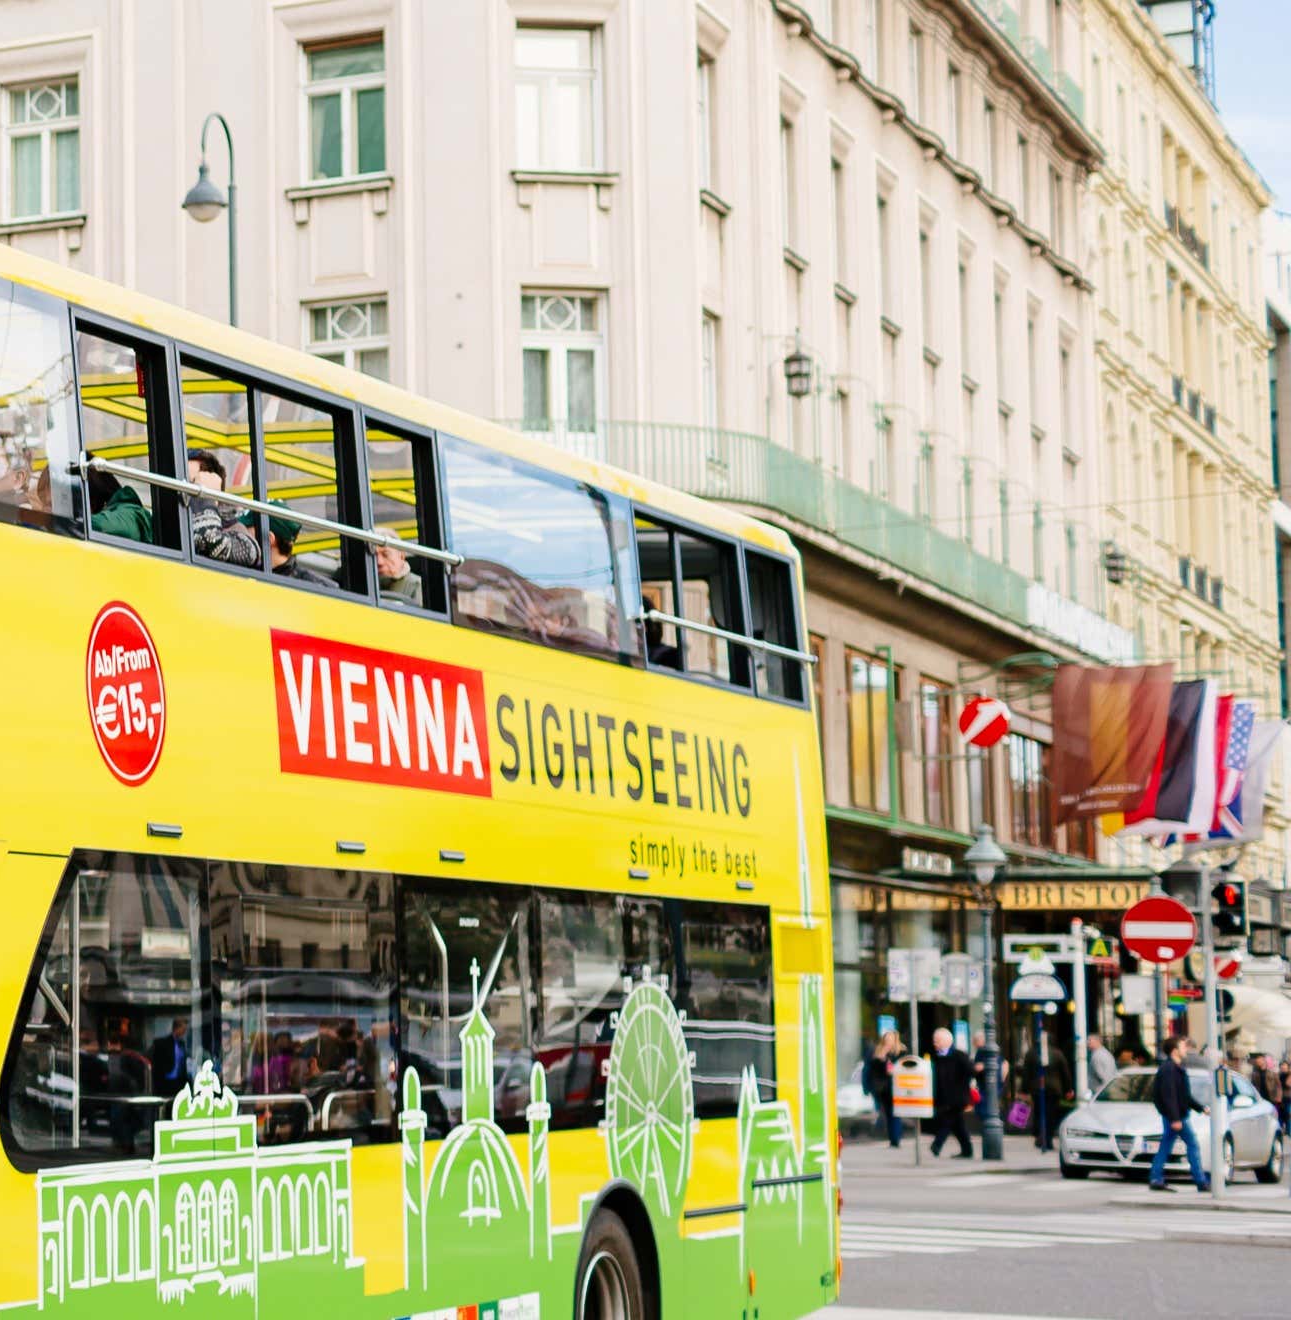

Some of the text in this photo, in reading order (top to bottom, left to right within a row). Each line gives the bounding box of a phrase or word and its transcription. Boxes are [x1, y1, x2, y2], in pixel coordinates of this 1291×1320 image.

[94, 643, 152, 678] Ab/From
[95, 681, 162, 741] €15,-
[279, 649, 752, 818] VIENNA SIGHTSEEING
[630, 832, 758, 878] simply the best
